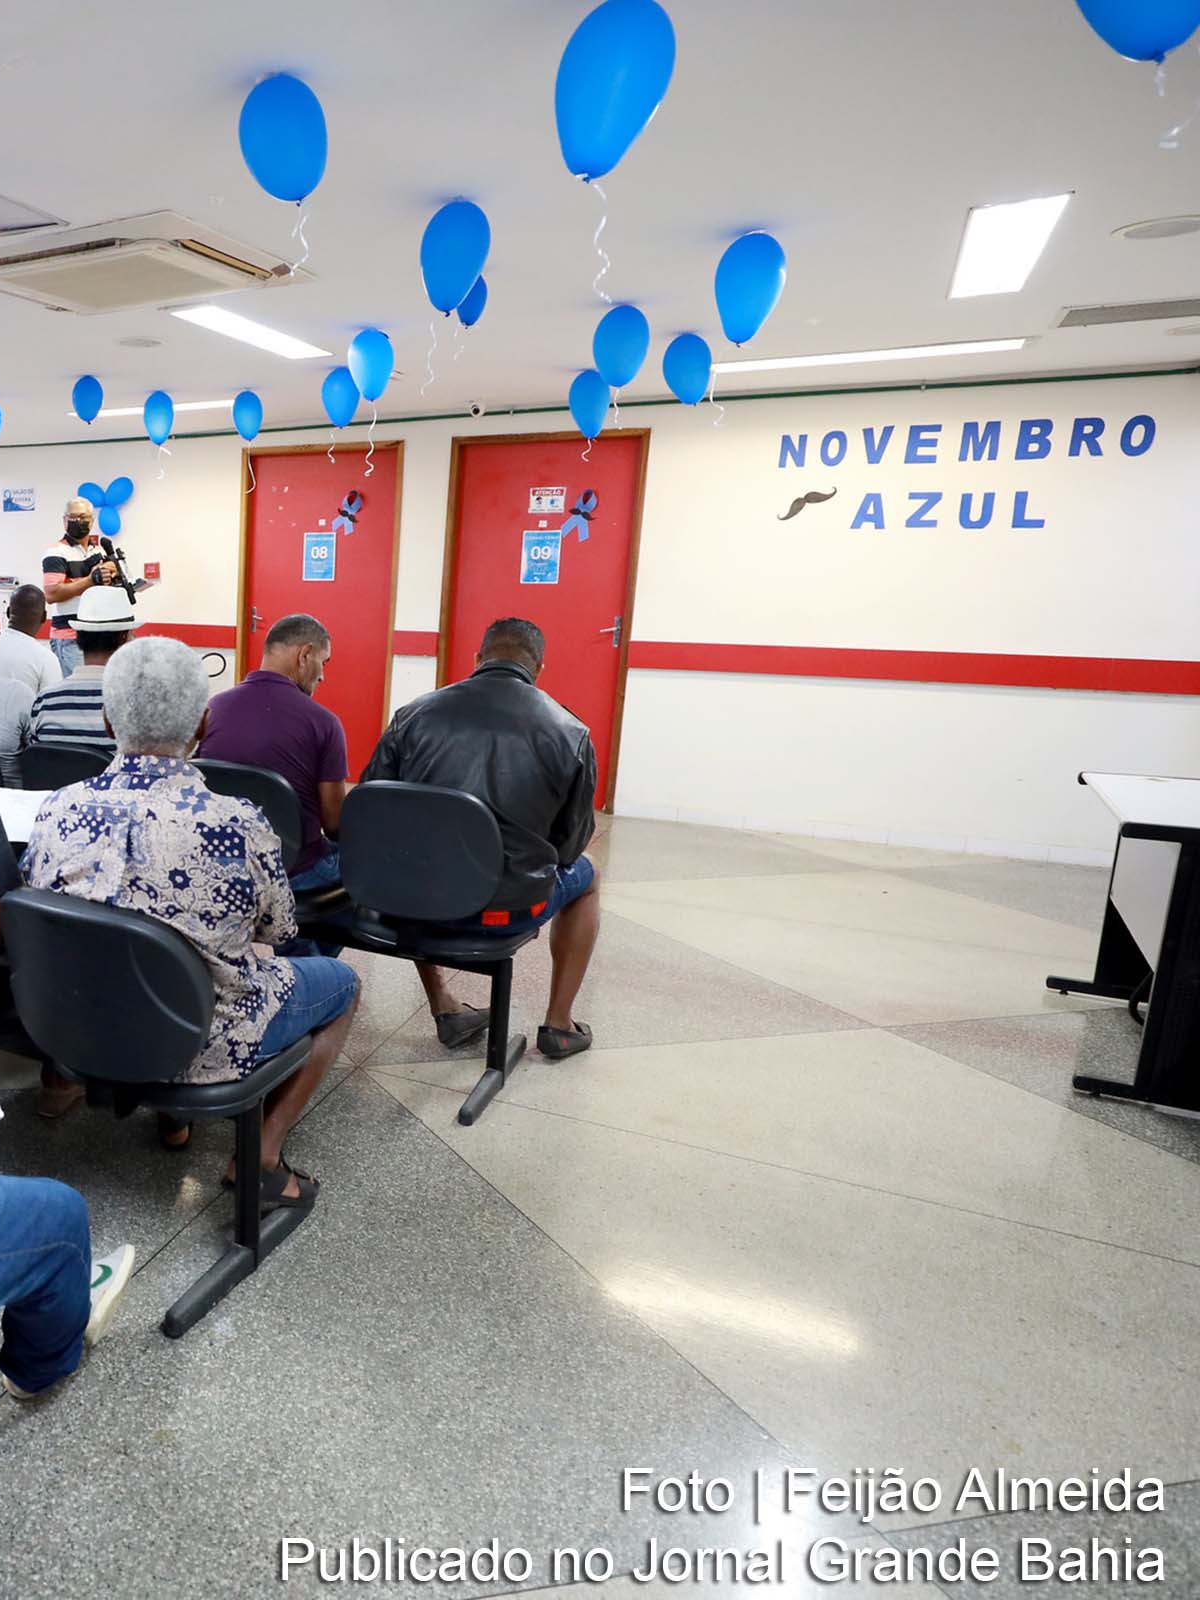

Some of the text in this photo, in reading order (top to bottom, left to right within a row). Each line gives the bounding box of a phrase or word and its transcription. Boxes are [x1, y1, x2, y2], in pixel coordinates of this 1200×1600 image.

[777, 414, 1157, 468] NOVEMBRO
[849, 490, 1046, 530] AZUL
[311, 546, 328, 560] 08
[530, 545, 552, 561] 09
